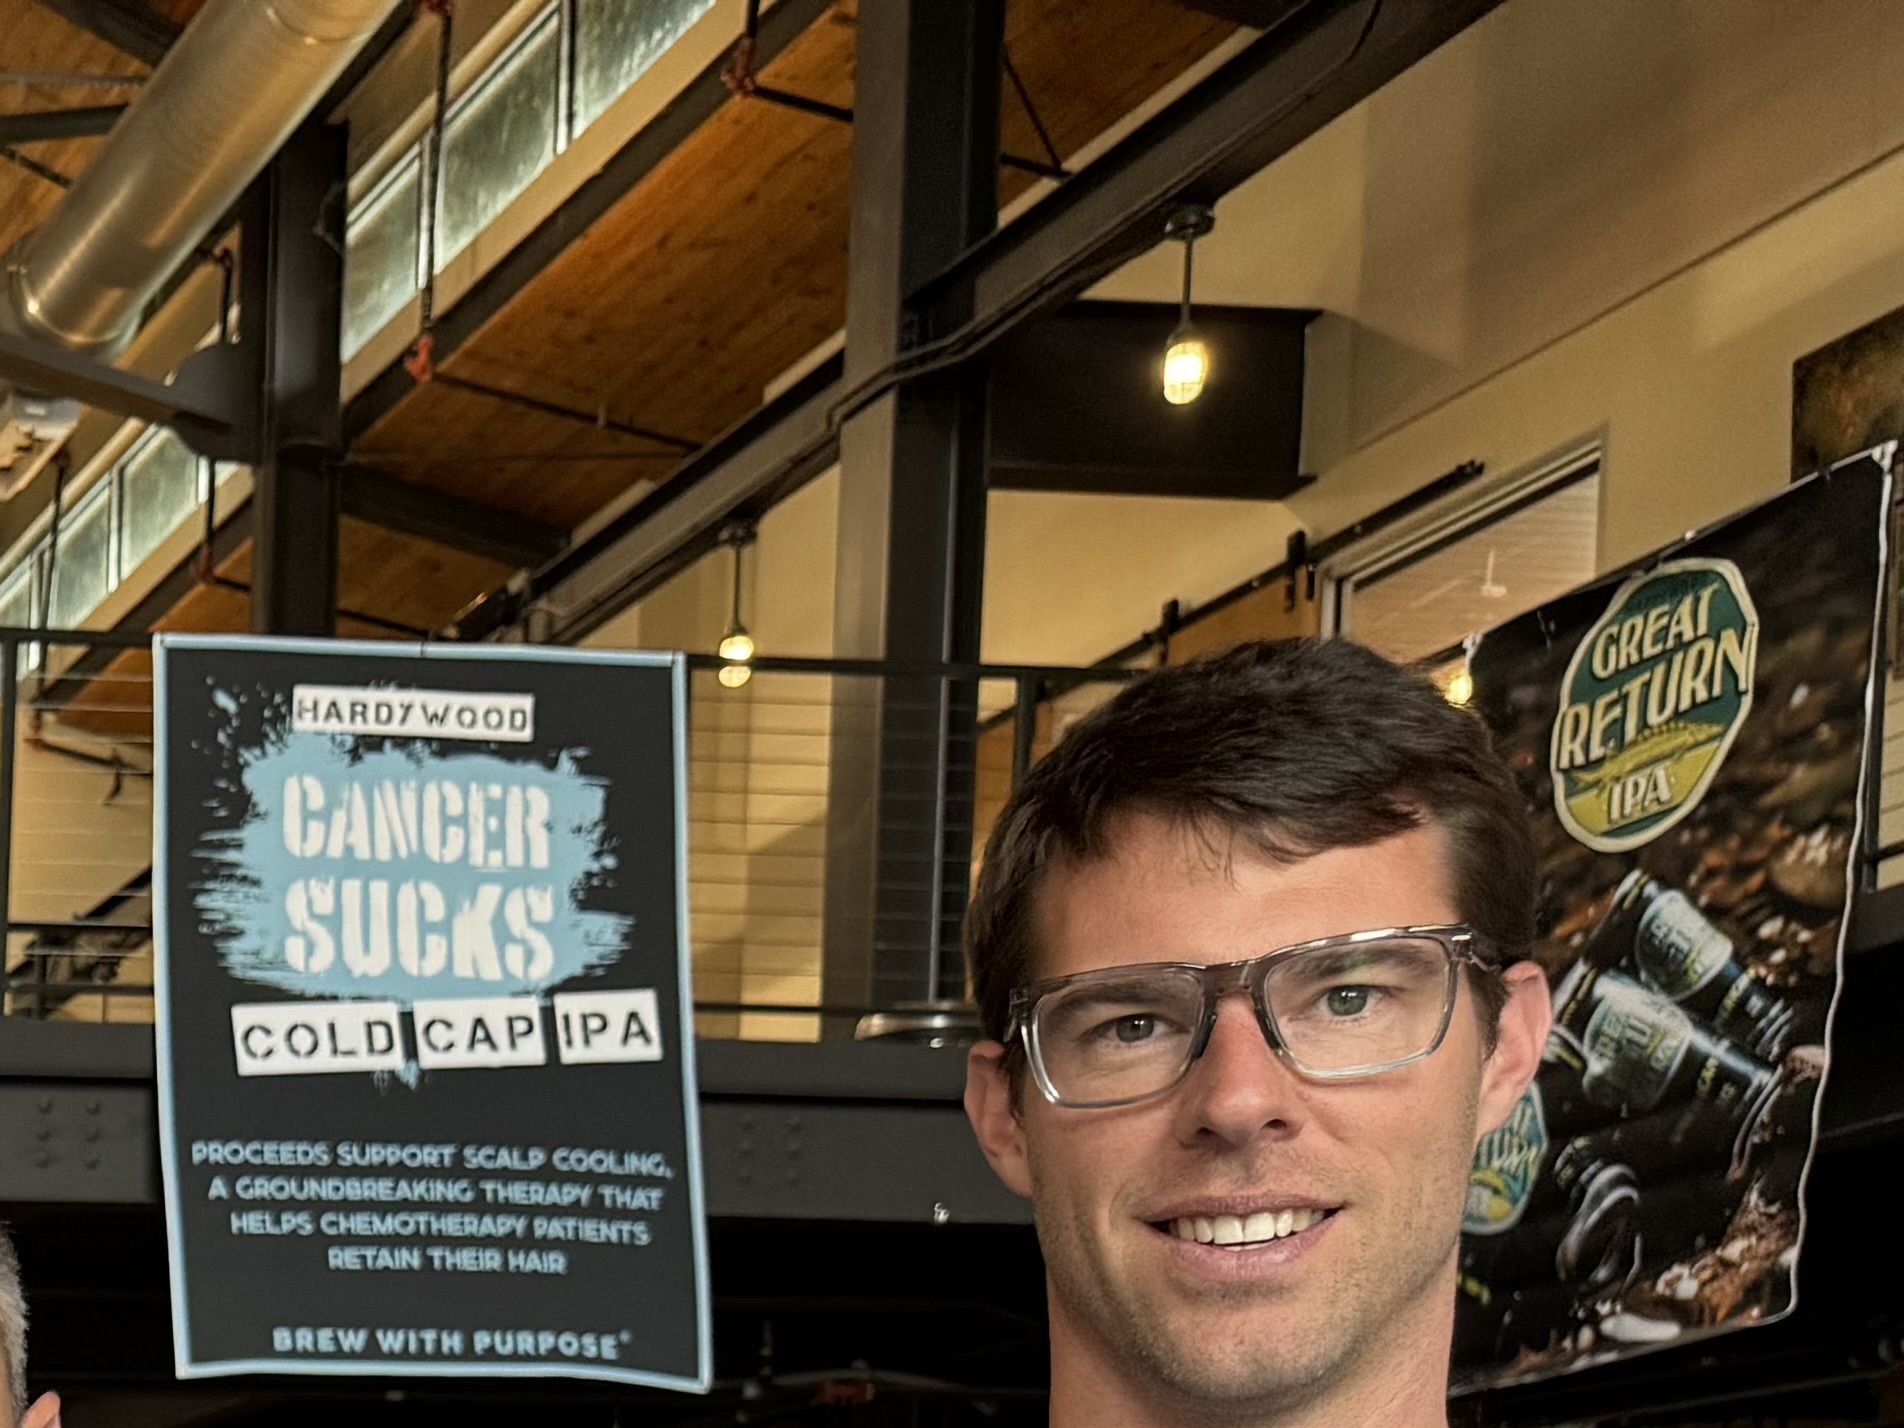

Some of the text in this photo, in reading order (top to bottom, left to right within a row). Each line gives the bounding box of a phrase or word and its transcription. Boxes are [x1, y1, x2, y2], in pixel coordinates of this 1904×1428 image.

[1593, 581, 1719, 679] GREAT
[296, 699, 530, 733] HARDYWOOD
[1559, 627, 1748, 770] RETURN
[1609, 761, 1673, 822] IPA
[283, 775, 553, 870] CANCER
[284, 877, 555, 982] SUCKS
[241, 1008, 653, 1059] COLD CAP IPA
[191, 1140, 676, 1179] PROCEEDS SUPPORT SCALP COOLING,
[207, 1176, 665, 1211] A GROUNDBREAKING THERAPY THAT
[231, 1211, 652, 1245] HELPS CHEMOTHERAPY PATIENTS
[329, 1245, 567, 1274] RETAIN THEIR HAIR
[273, 1327, 369, 1353] BREW
[375, 1329, 463, 1355] WITH
